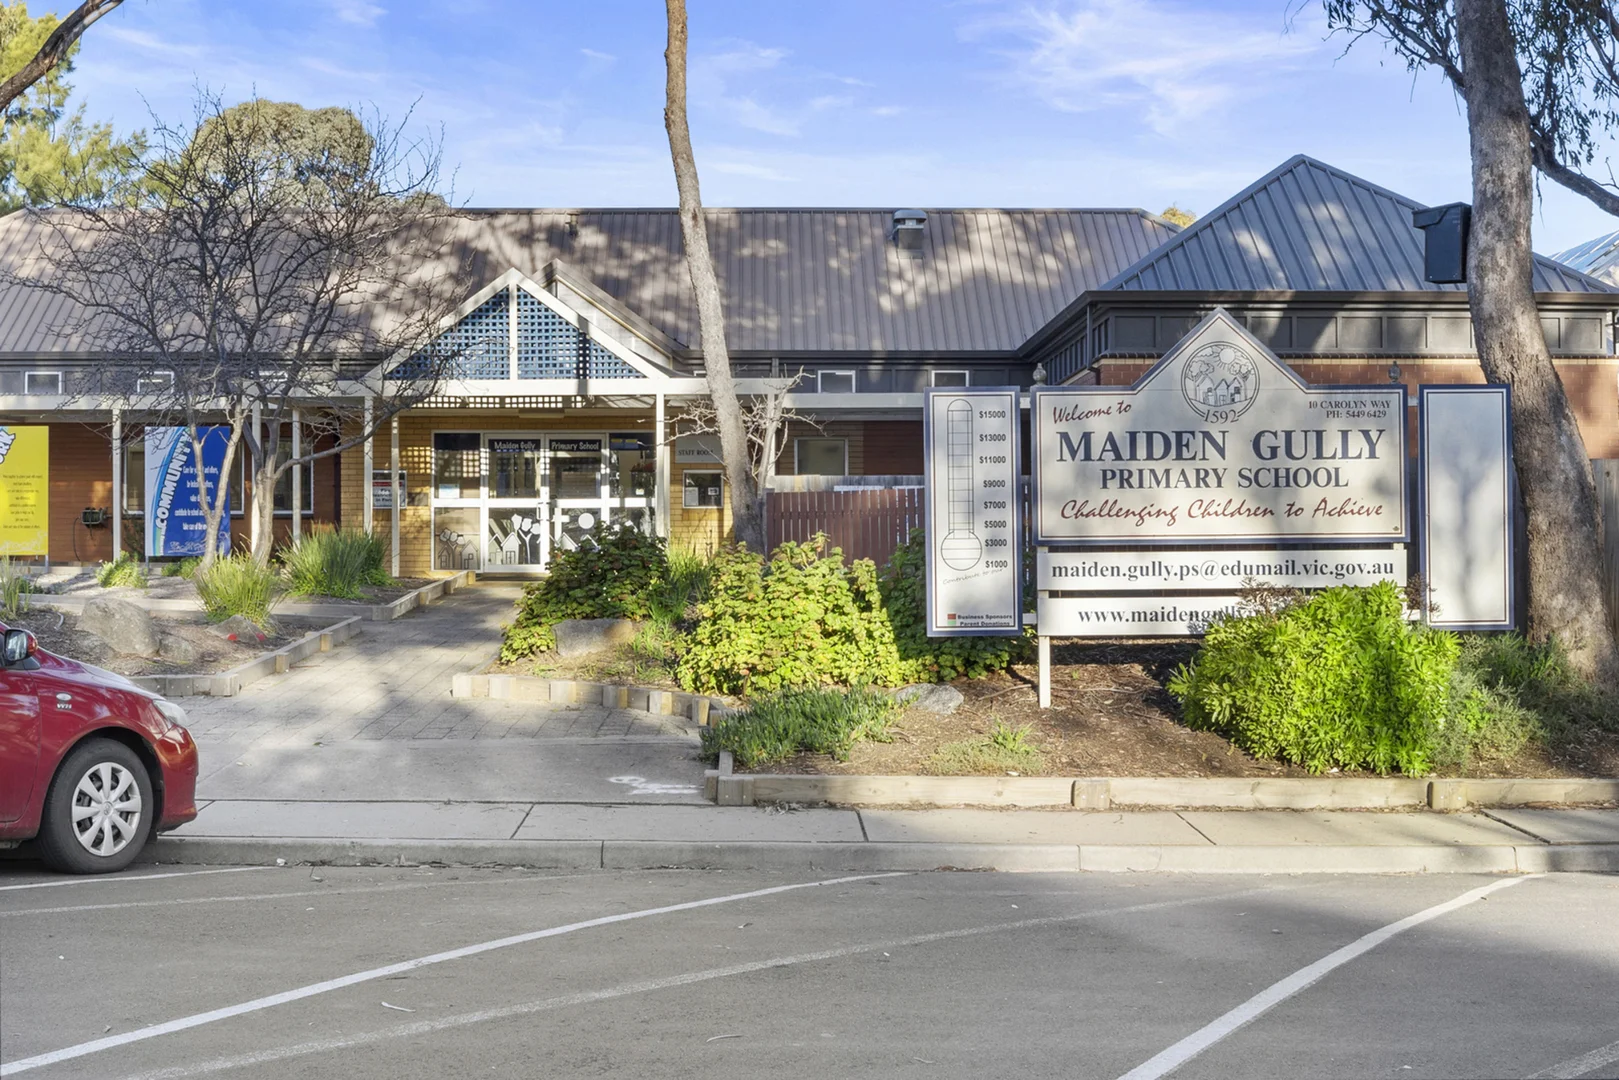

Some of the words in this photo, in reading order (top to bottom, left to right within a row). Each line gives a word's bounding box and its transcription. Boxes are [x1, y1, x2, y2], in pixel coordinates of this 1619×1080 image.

[1308, 401, 1318, 409] 10
[1320, 400, 1367, 409] CAROLYN
[1371, 400, 1392, 409] WAY
[979, 410, 1006, 419] $15000
[1053, 403, 1112, 424] Welcome
[1116, 400, 1132, 414] to
[1204, 409, 1239, 424] 1592
[1326, 410, 1343, 419] PH:
[1345, 410, 1365, 418] 5449
[1366, 410, 1387, 418] 6429
[979, 433, 1006, 442] $13000
[494, 441, 519, 450] Maiden
[551, 441, 577, 451] Primary
[579, 441, 599, 450] School
[1056, 430, 1229, 462] MAIDEN
[1252, 429, 1387, 461] GULLY
[979, 455, 1007, 464] $11000
[156, 430, 192, 529] COMMUNITY
[1099, 468, 1228, 490] PRIMARY
[1237, 467, 1349, 489] SCHOOL
[983, 480, 1006, 488] $9000
[983, 501, 1006, 509] $7000
[1060, 499, 1179, 527] Challenging
[1187, 498, 1275, 519] Children
[1284, 500, 1305, 518] to
[1311, 496, 1384, 519] Achieve
[984, 520, 1007, 528] $5000
[984, 538, 1008, 547] $3000
[985, 560, 1008, 568] $1000
[1051, 559, 1395, 582] maiden.gully.ps@edumail.vic.gov.au
